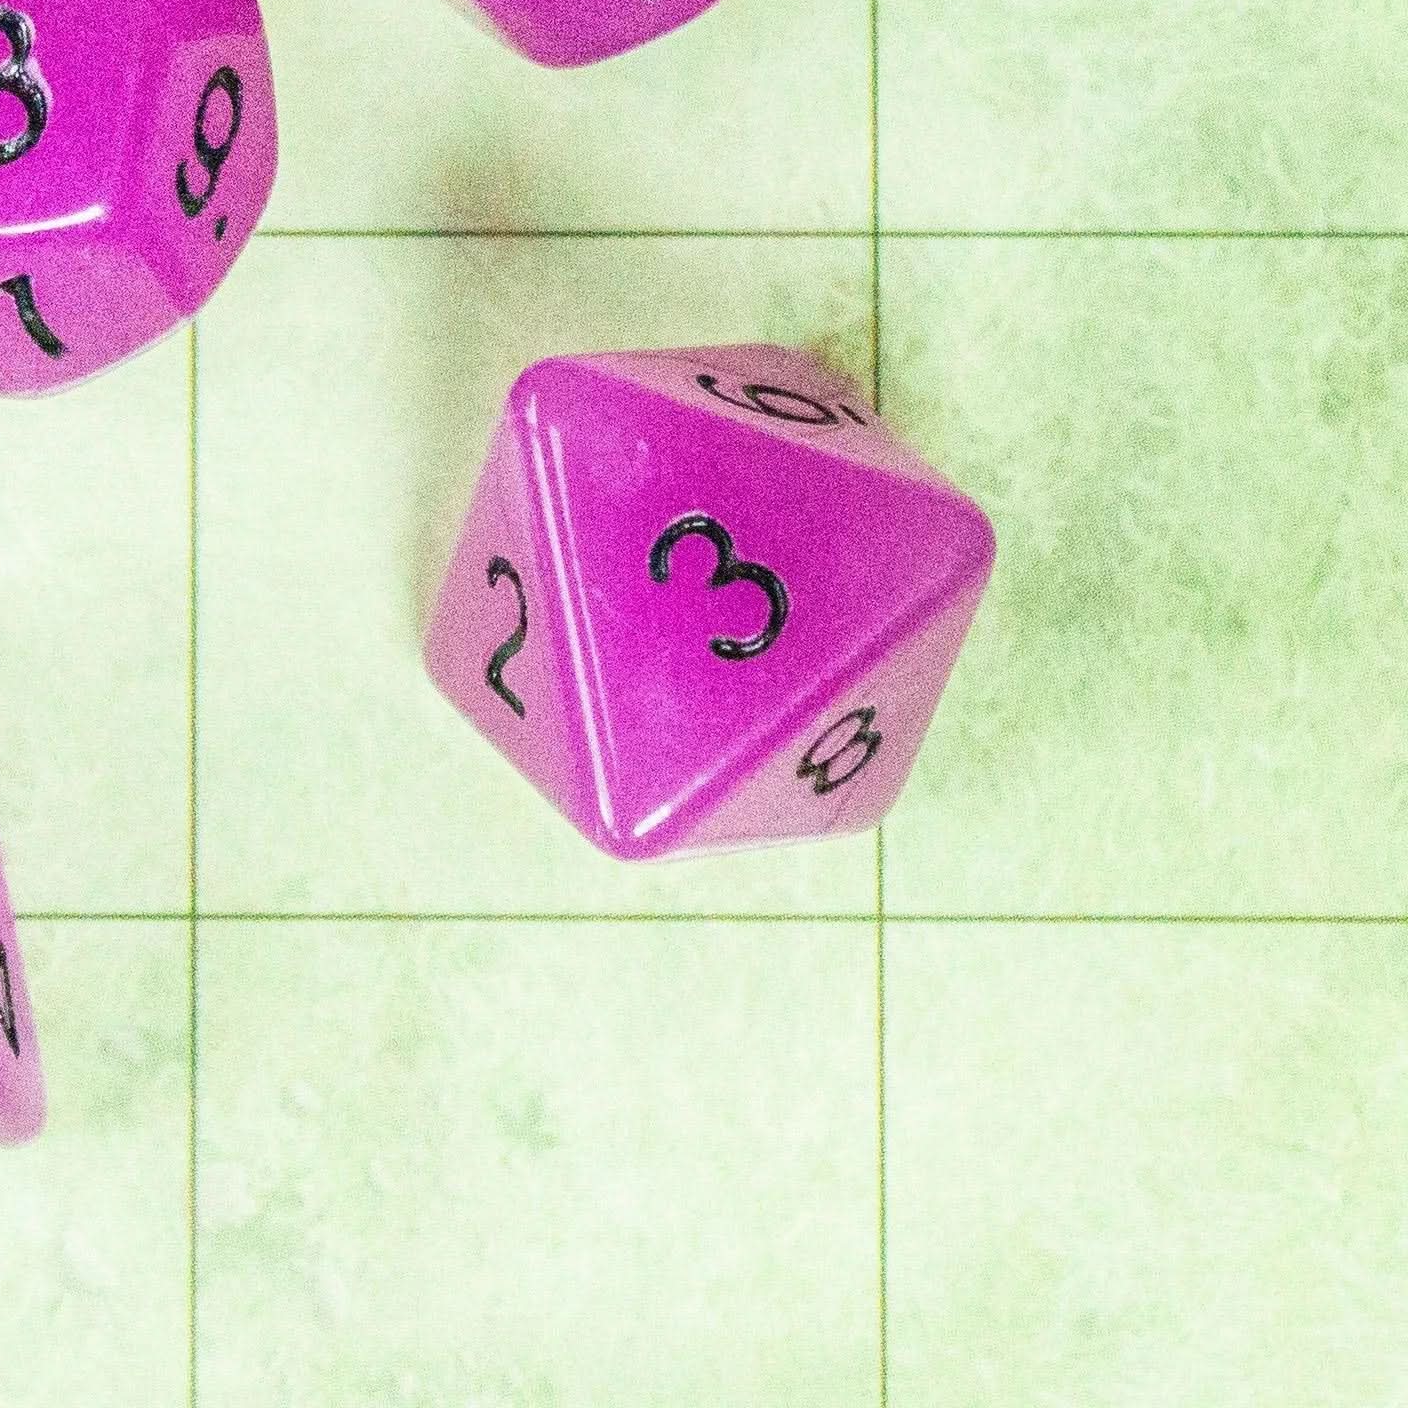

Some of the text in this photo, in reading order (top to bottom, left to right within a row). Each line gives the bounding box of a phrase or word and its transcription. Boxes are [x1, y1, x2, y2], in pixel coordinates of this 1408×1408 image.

[485, 555, 529, 718] 2
[647, 514, 790, 663] 3
[795, 705, 884, 796] 8
